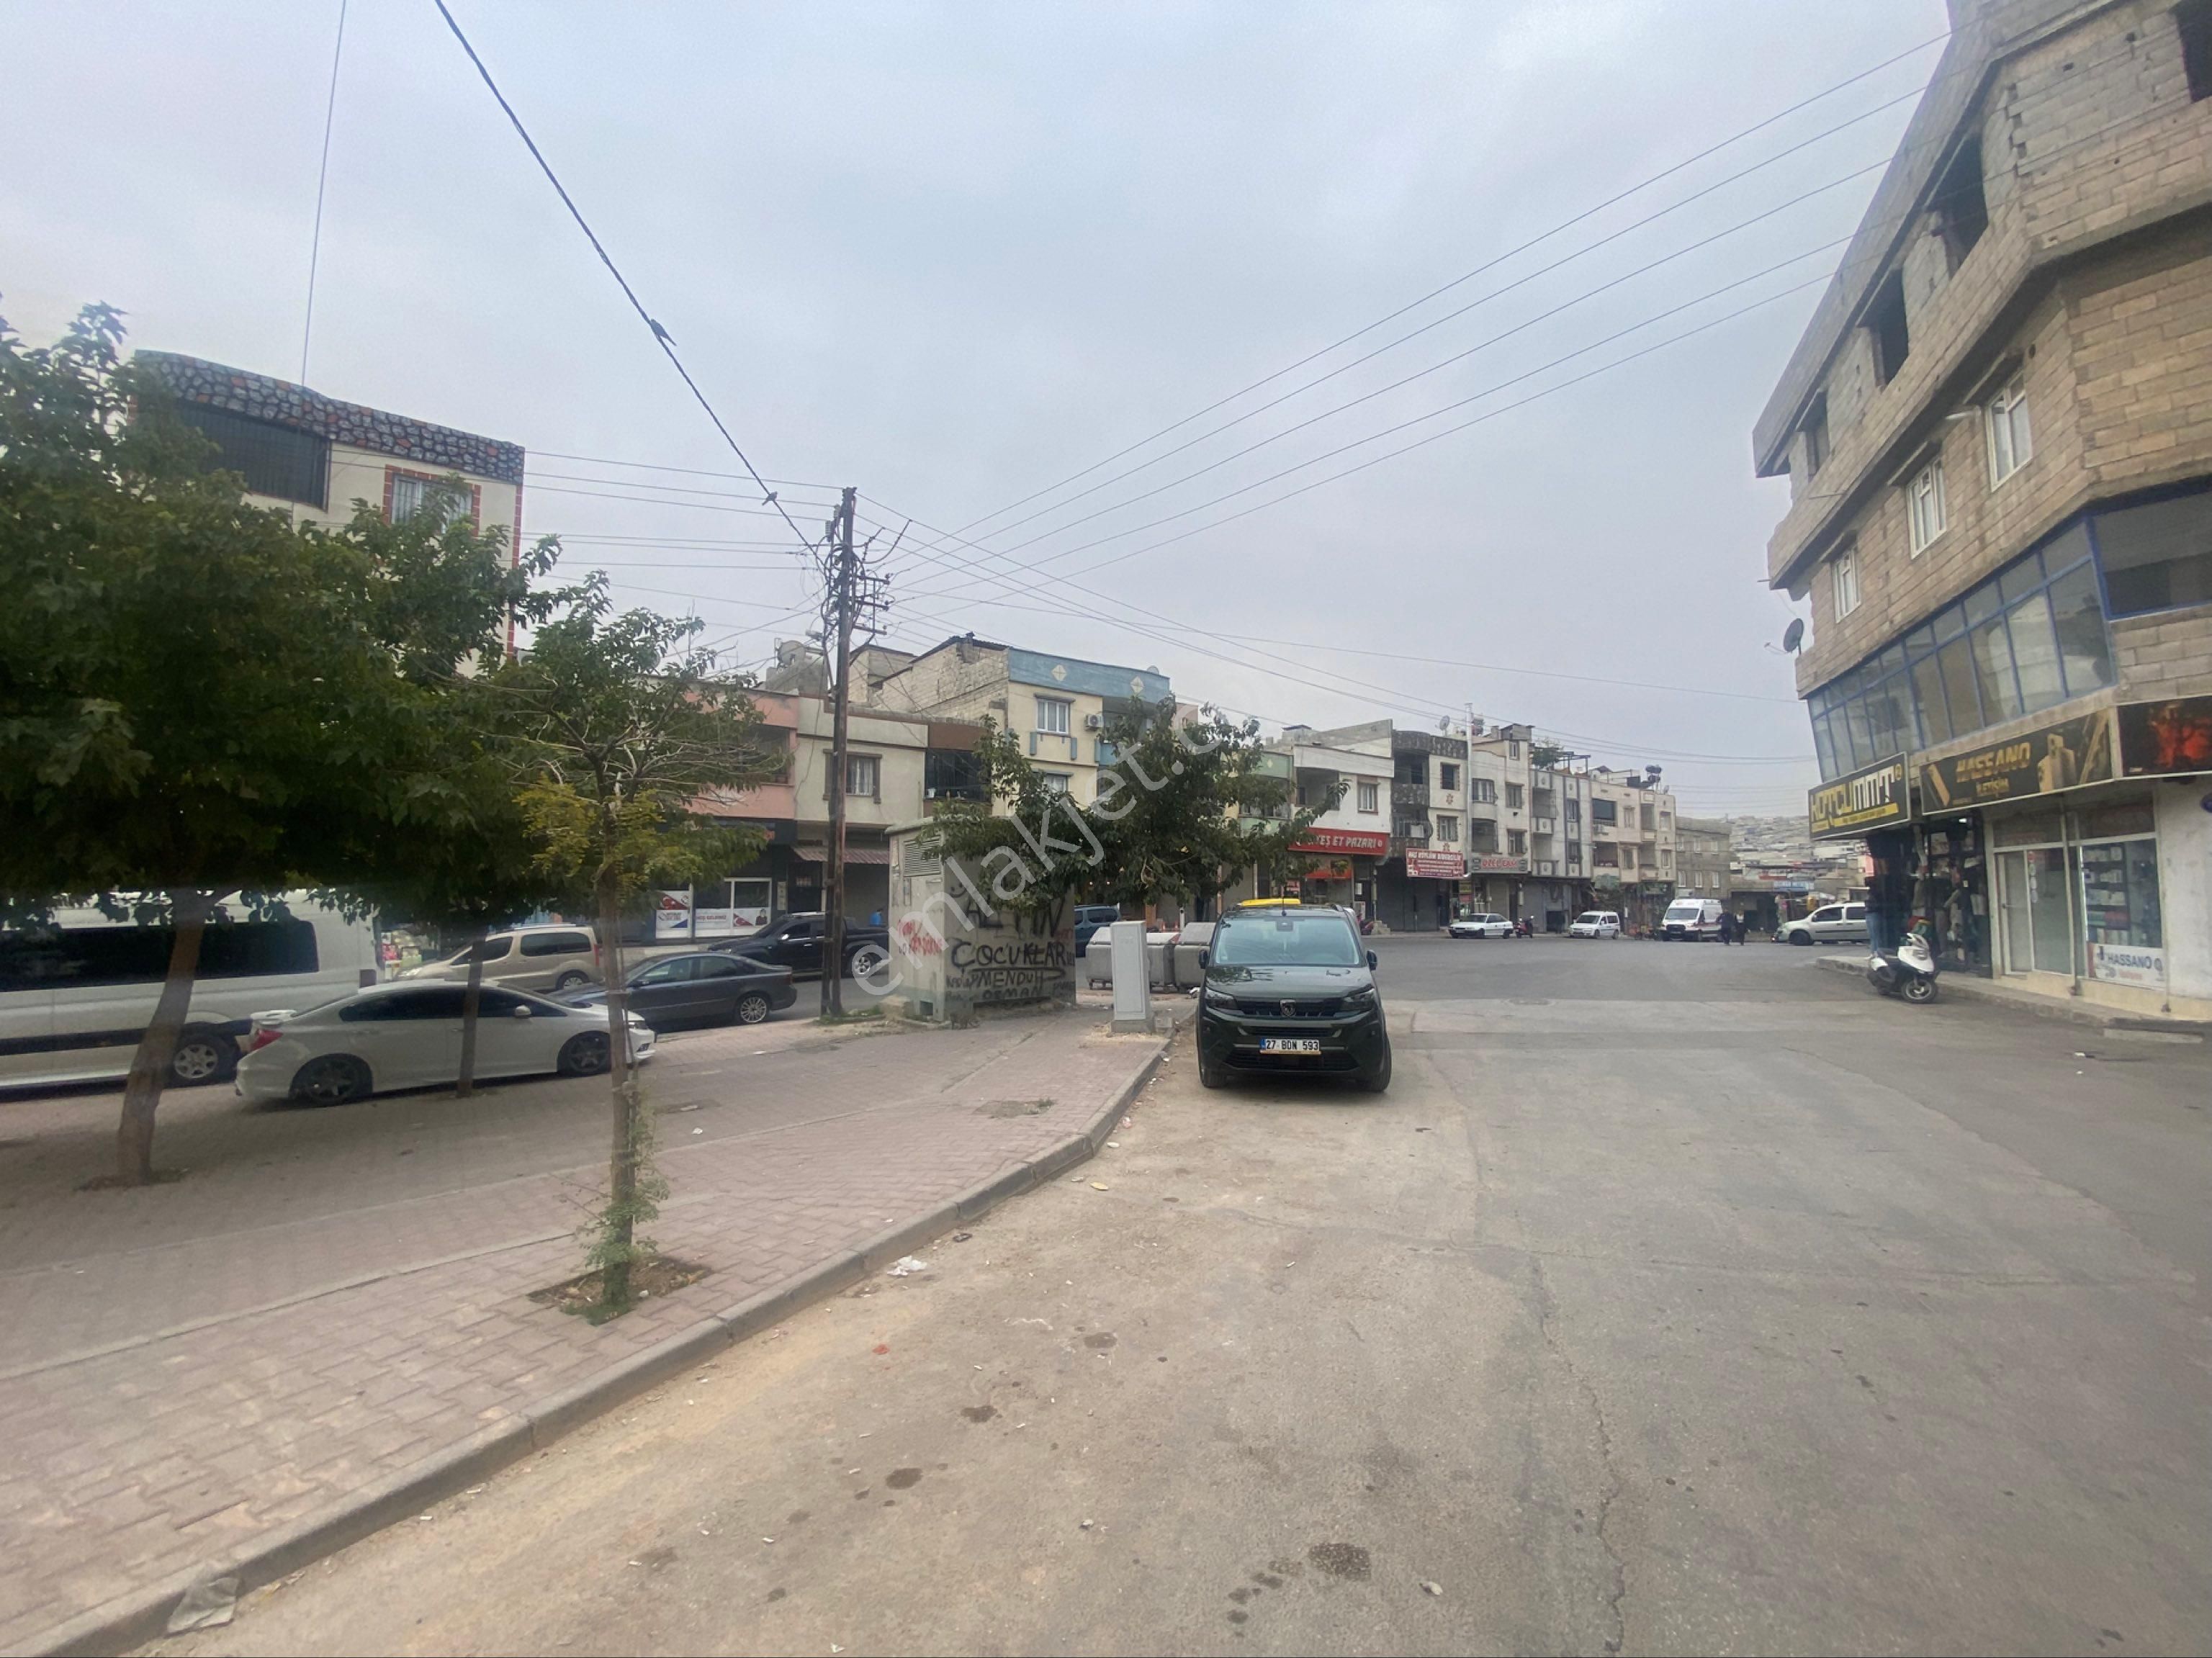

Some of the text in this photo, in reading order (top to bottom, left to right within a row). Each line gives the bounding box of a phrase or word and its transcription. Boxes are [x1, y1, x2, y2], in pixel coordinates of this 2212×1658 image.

[1333, 836, 1343, 847] ET
[1345, 837, 1376, 849] PAZARI
[2108, 953, 2152, 969] HASSANO
[1267, 1040, 1276, 1050] 27
[1303, 1040, 1318, 1050] 593
